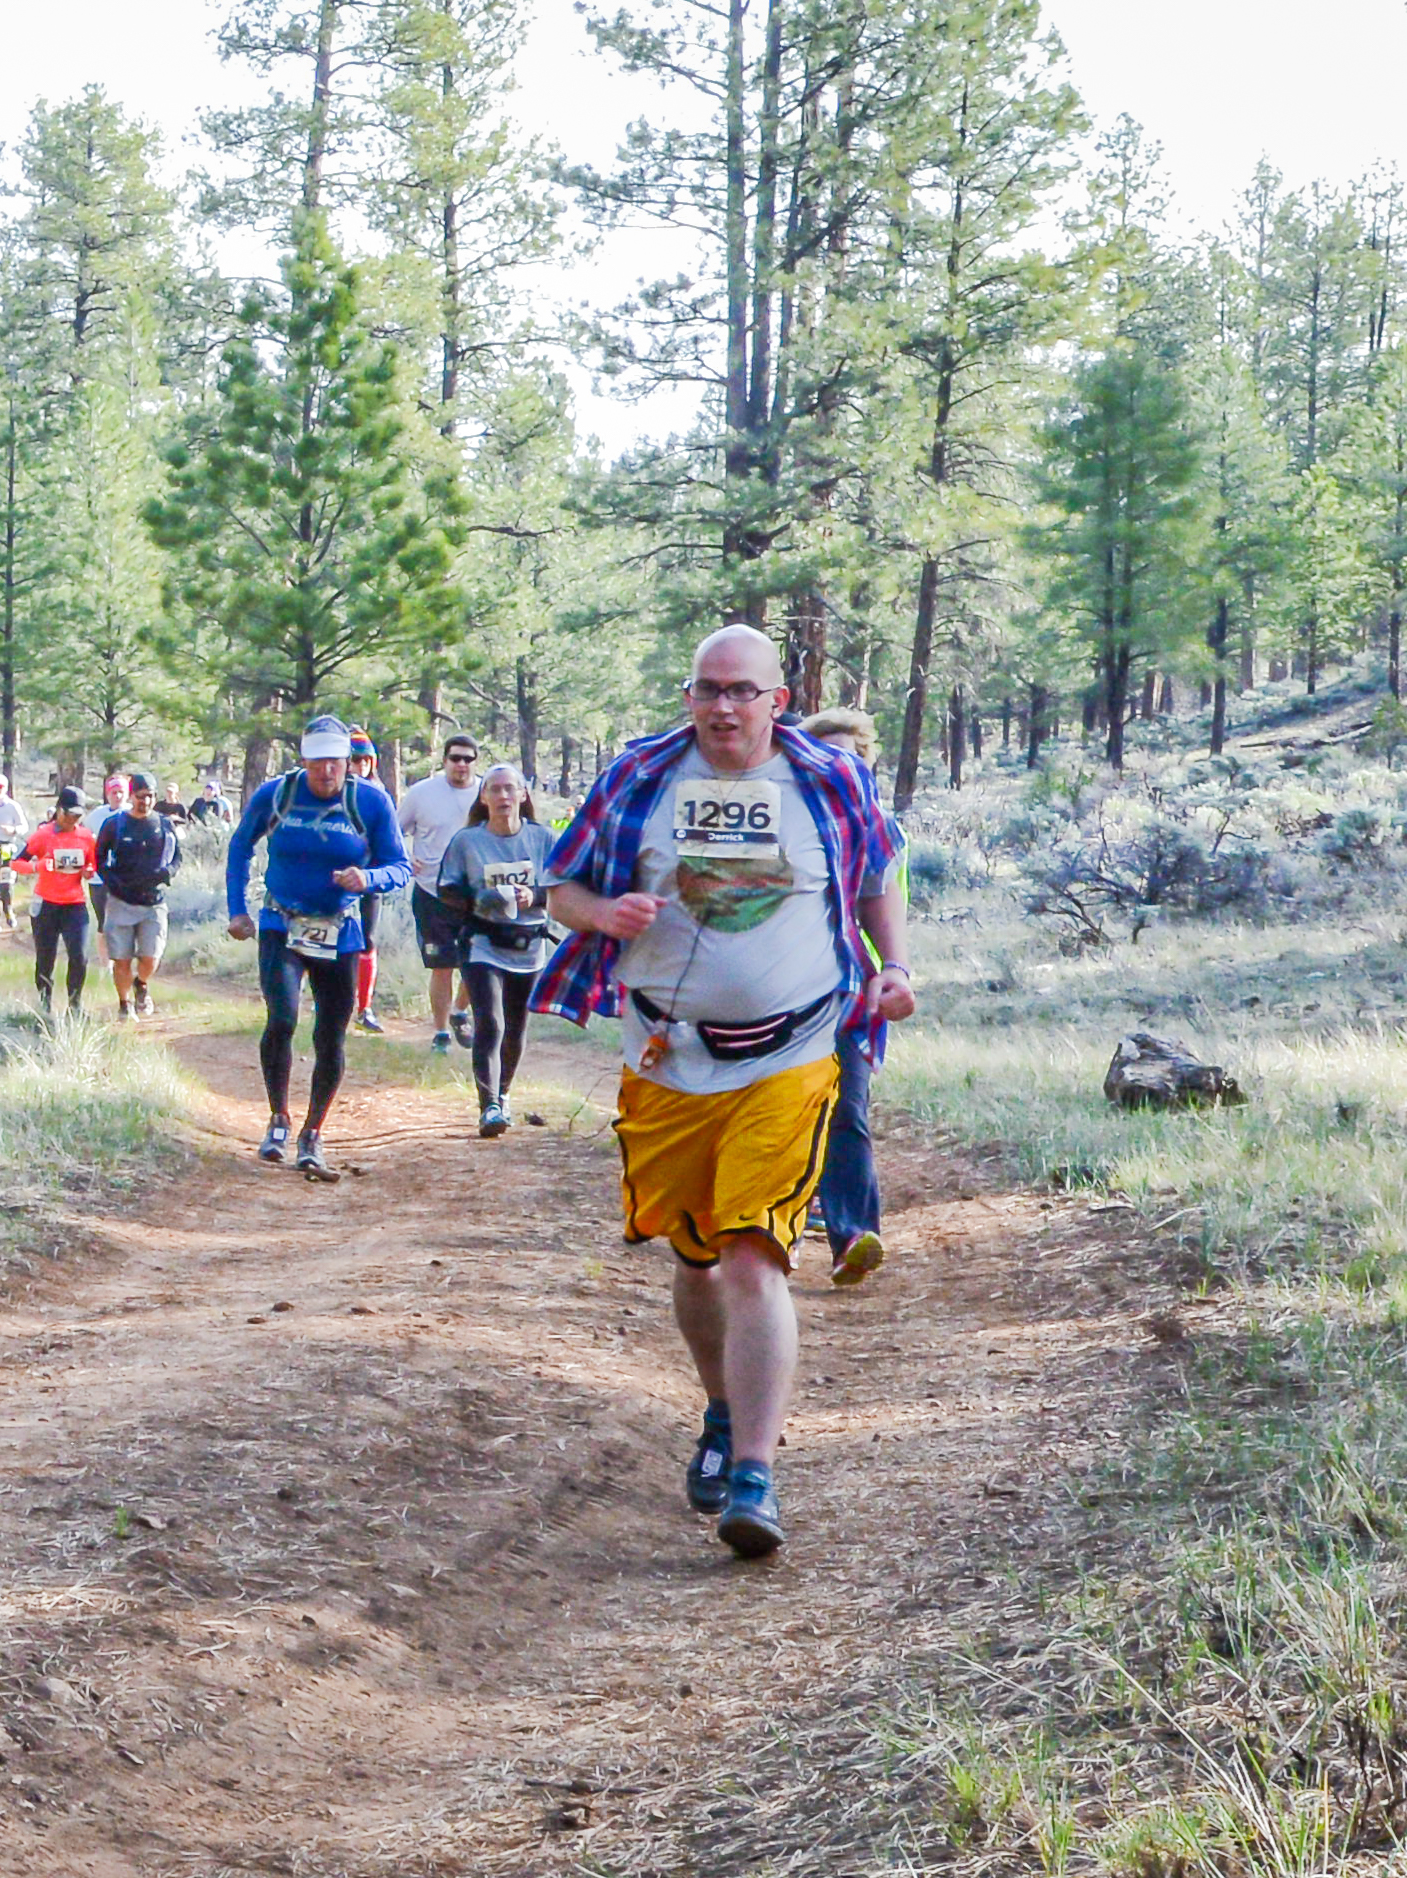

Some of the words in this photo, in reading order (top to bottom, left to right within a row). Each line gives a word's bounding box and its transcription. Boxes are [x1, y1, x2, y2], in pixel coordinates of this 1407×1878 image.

[684, 800, 771, 829] 1296
[707, 832, 744, 841] Derrick
[300, 926, 328, 943] 721
